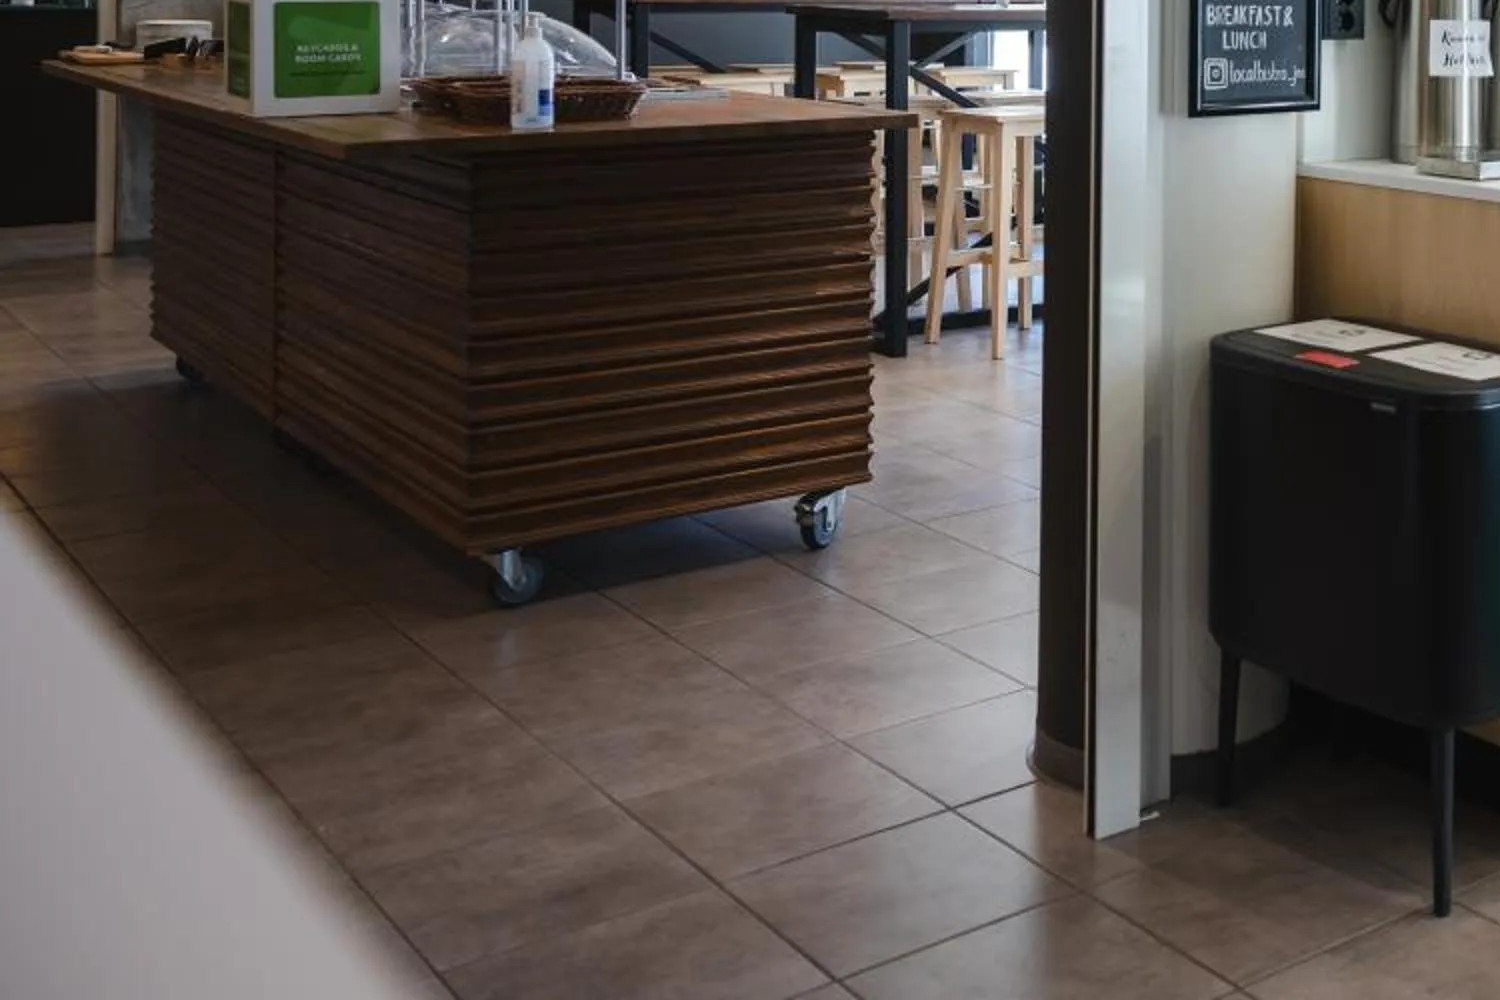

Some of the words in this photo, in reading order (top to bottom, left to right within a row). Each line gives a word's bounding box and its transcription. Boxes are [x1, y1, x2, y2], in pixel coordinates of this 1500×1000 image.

[1206, 3, 1280, 27] BREAKFAST
[1282, 6, 1293, 27] &
[1222, 30, 1267, 50] LUNCH
